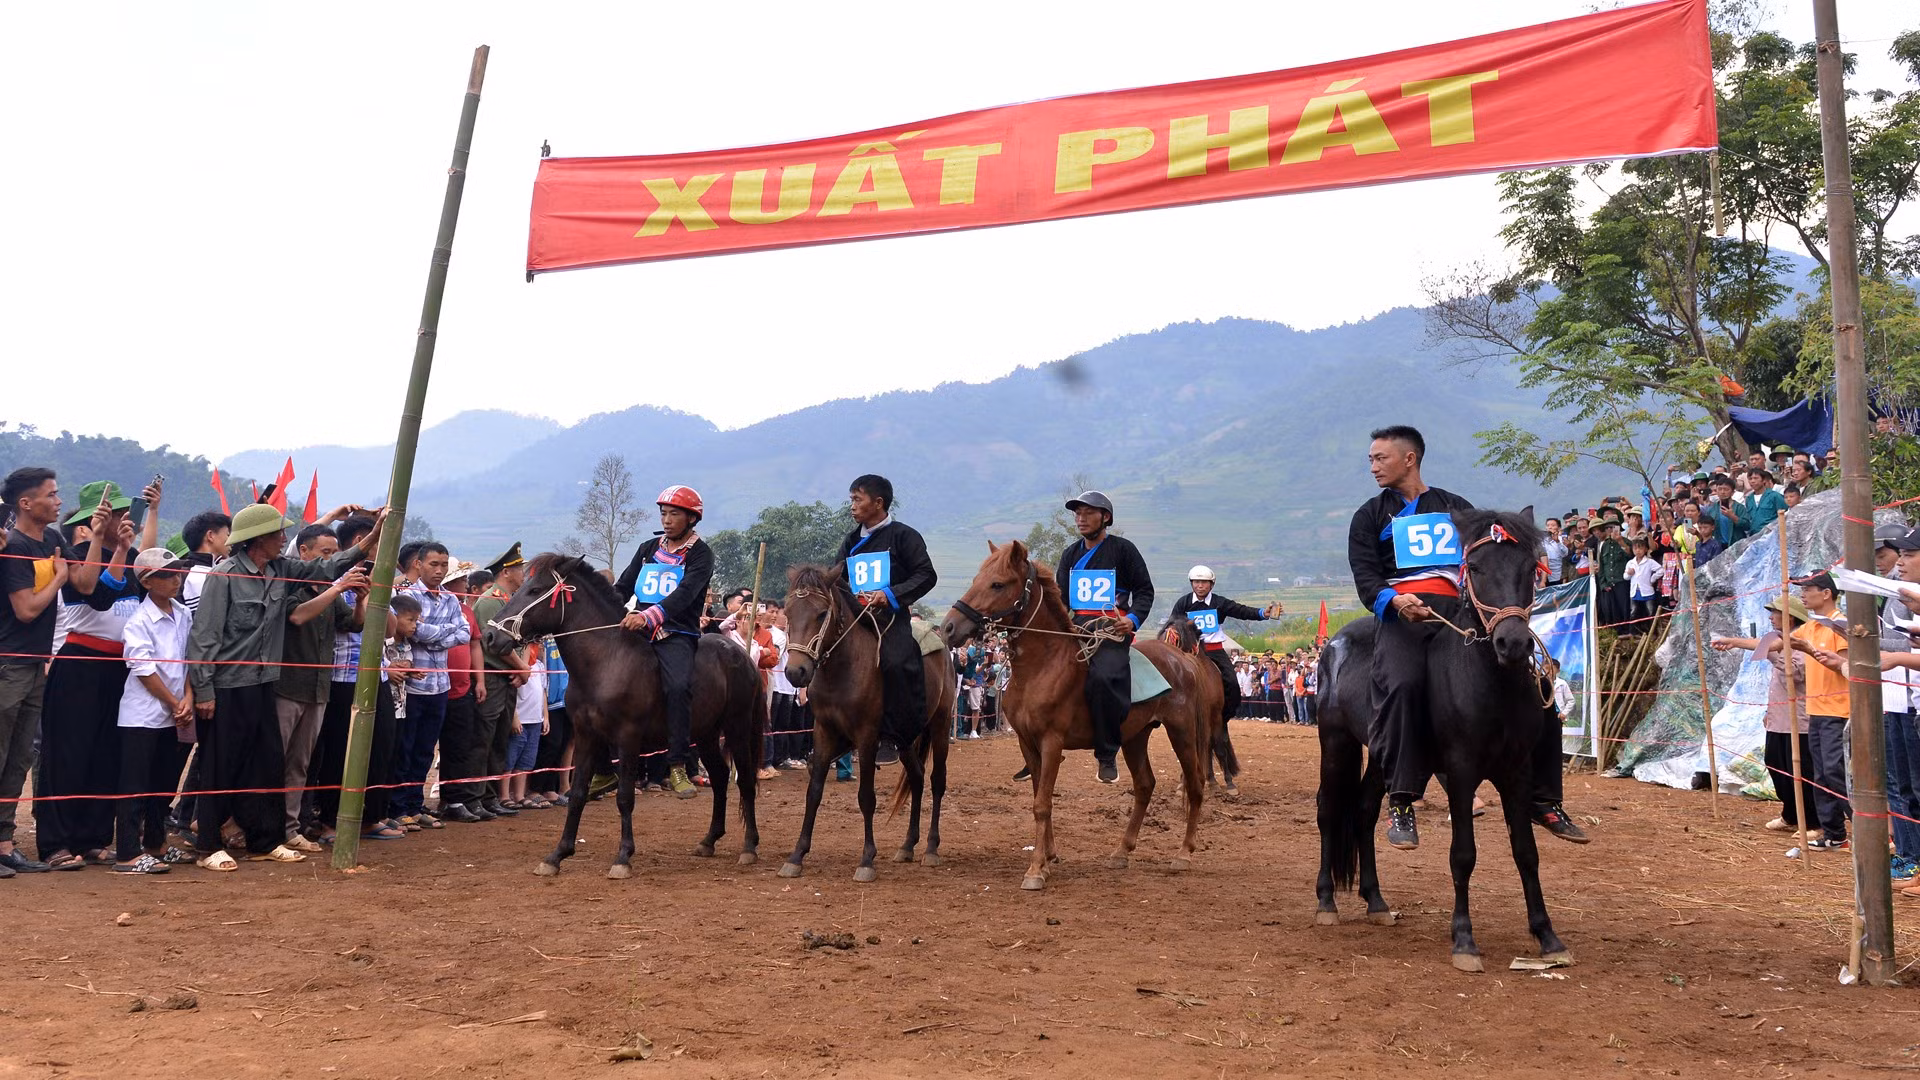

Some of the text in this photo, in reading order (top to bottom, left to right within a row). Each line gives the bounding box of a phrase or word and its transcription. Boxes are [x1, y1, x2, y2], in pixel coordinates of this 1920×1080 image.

[633, 69, 1499, 238] XUẤT PHÁT
[1407, 522, 1457, 557] 52
[641, 570, 678, 597] 56
[854, 559, 882, 586] 81
[1077, 577, 1111, 603] 82
[1193, 613, 1216, 630] 59
